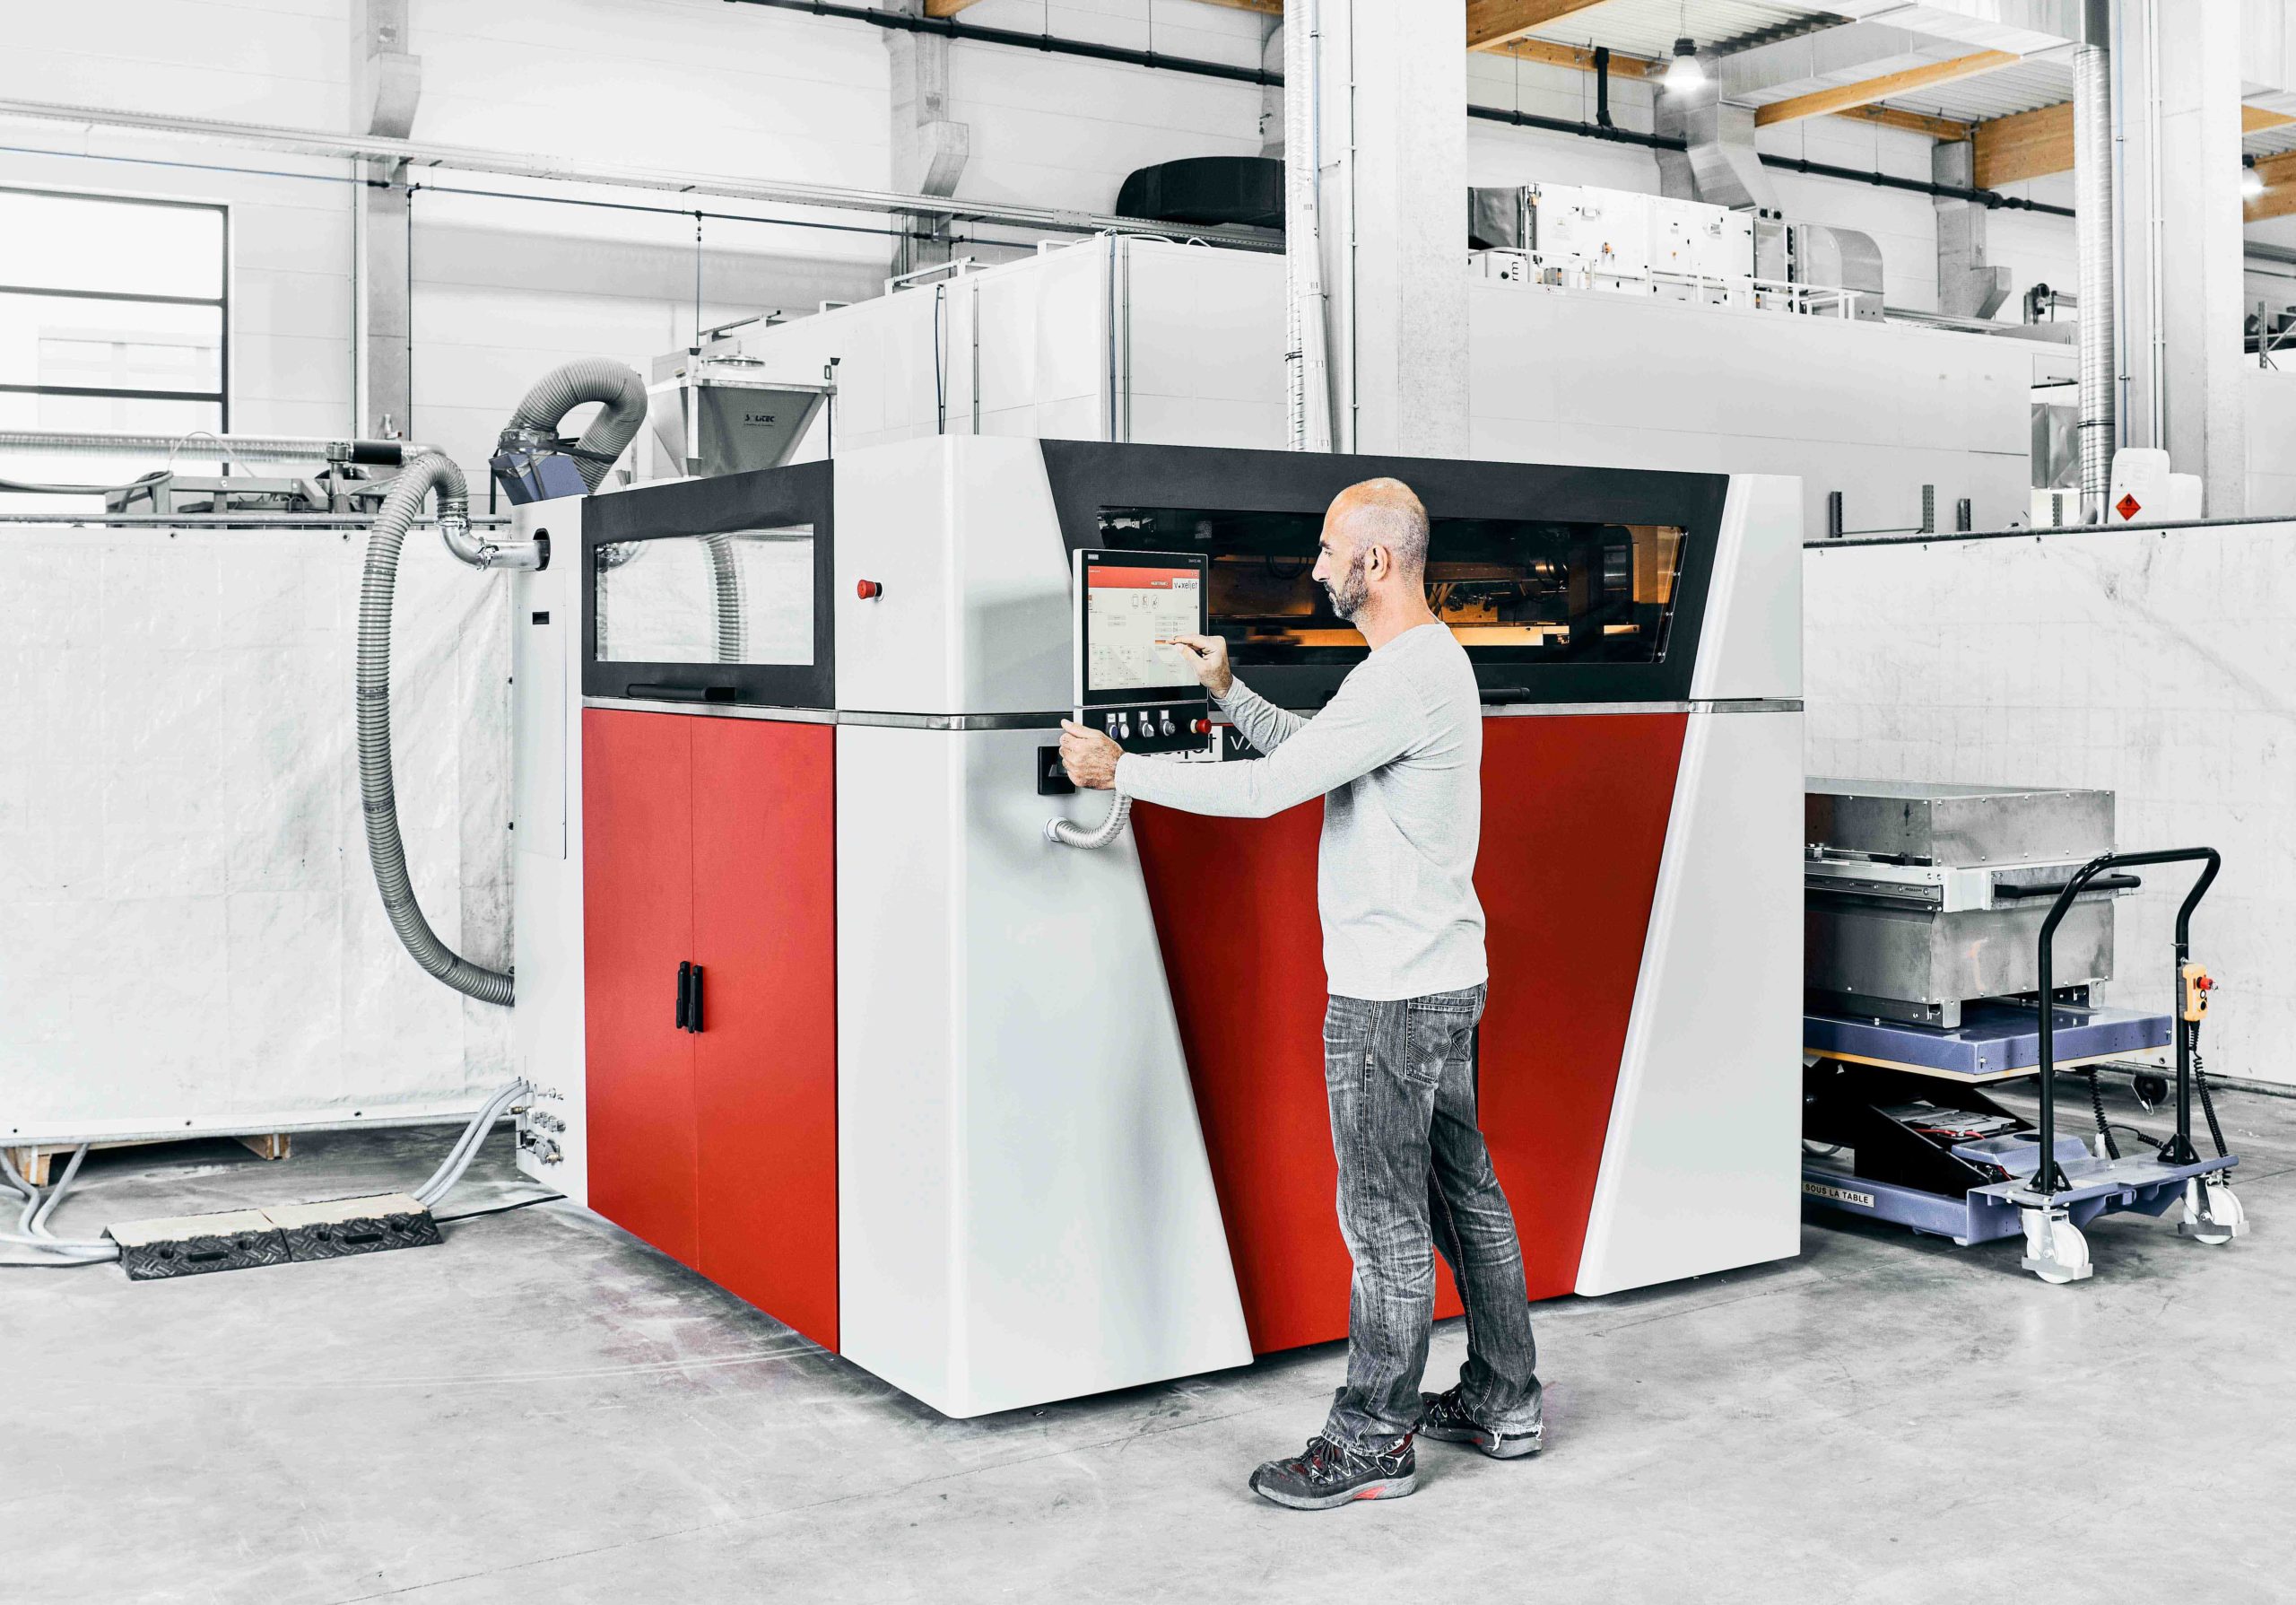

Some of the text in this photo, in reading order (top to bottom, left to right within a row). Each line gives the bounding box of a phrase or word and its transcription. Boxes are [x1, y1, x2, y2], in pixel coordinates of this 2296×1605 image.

[1805, 1183, 1869, 1204] SOUS LA TABLE
